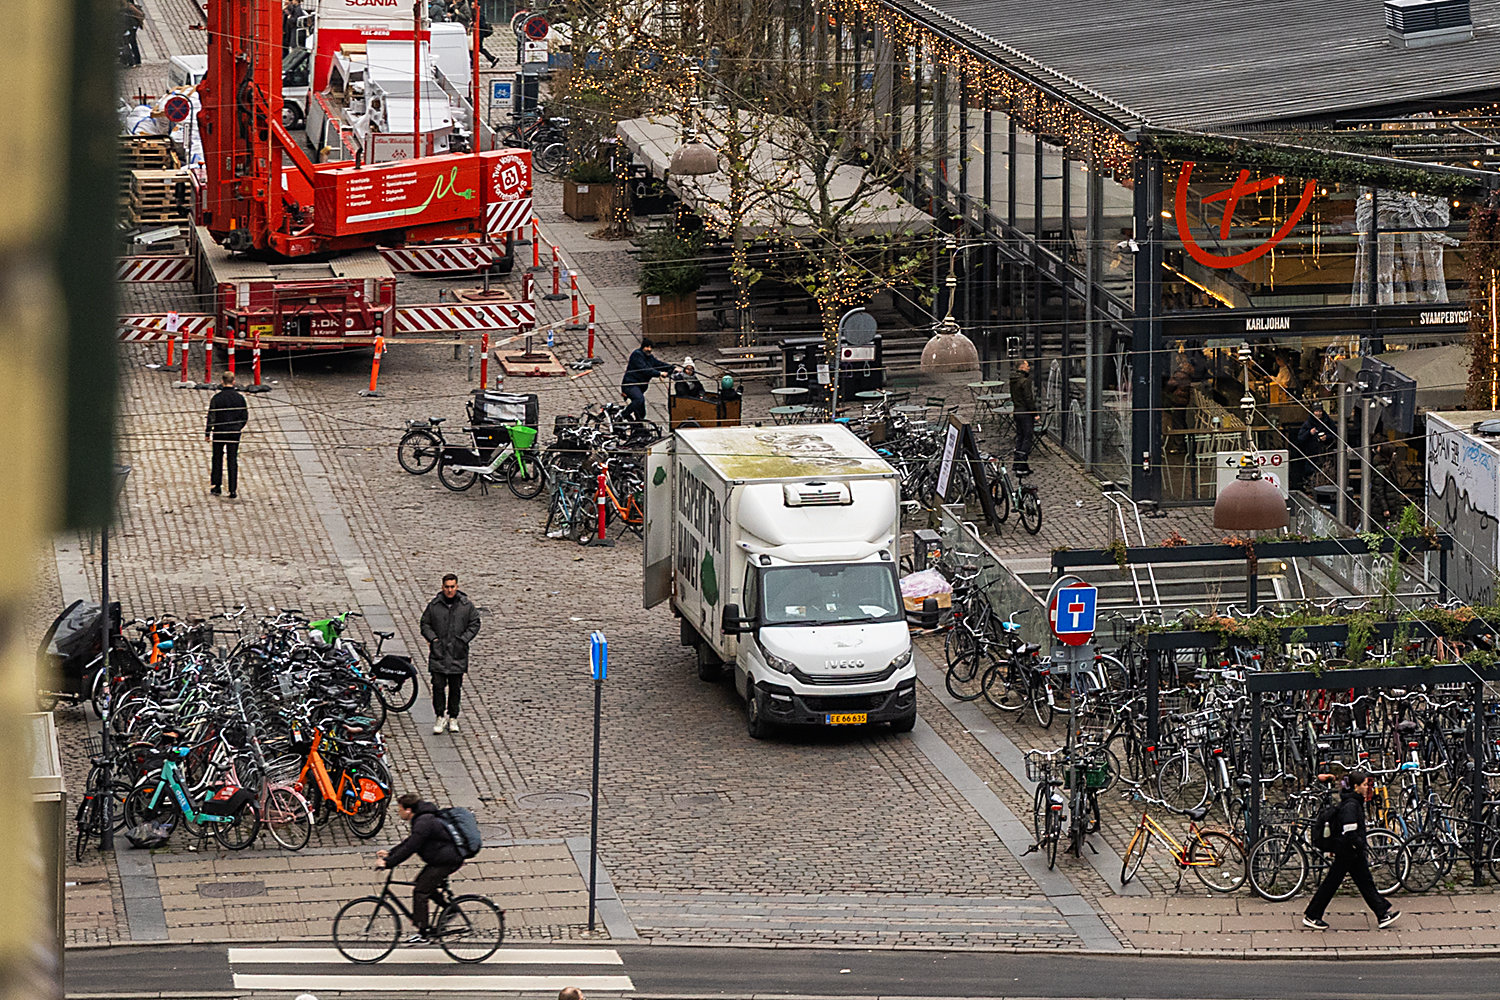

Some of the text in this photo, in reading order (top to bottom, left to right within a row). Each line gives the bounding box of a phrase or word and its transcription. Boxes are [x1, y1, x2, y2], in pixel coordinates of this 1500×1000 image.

[824, 660, 865, 669] IVECO
[831, 715, 841, 723] EE
[852, 714, 866, 722] 635
